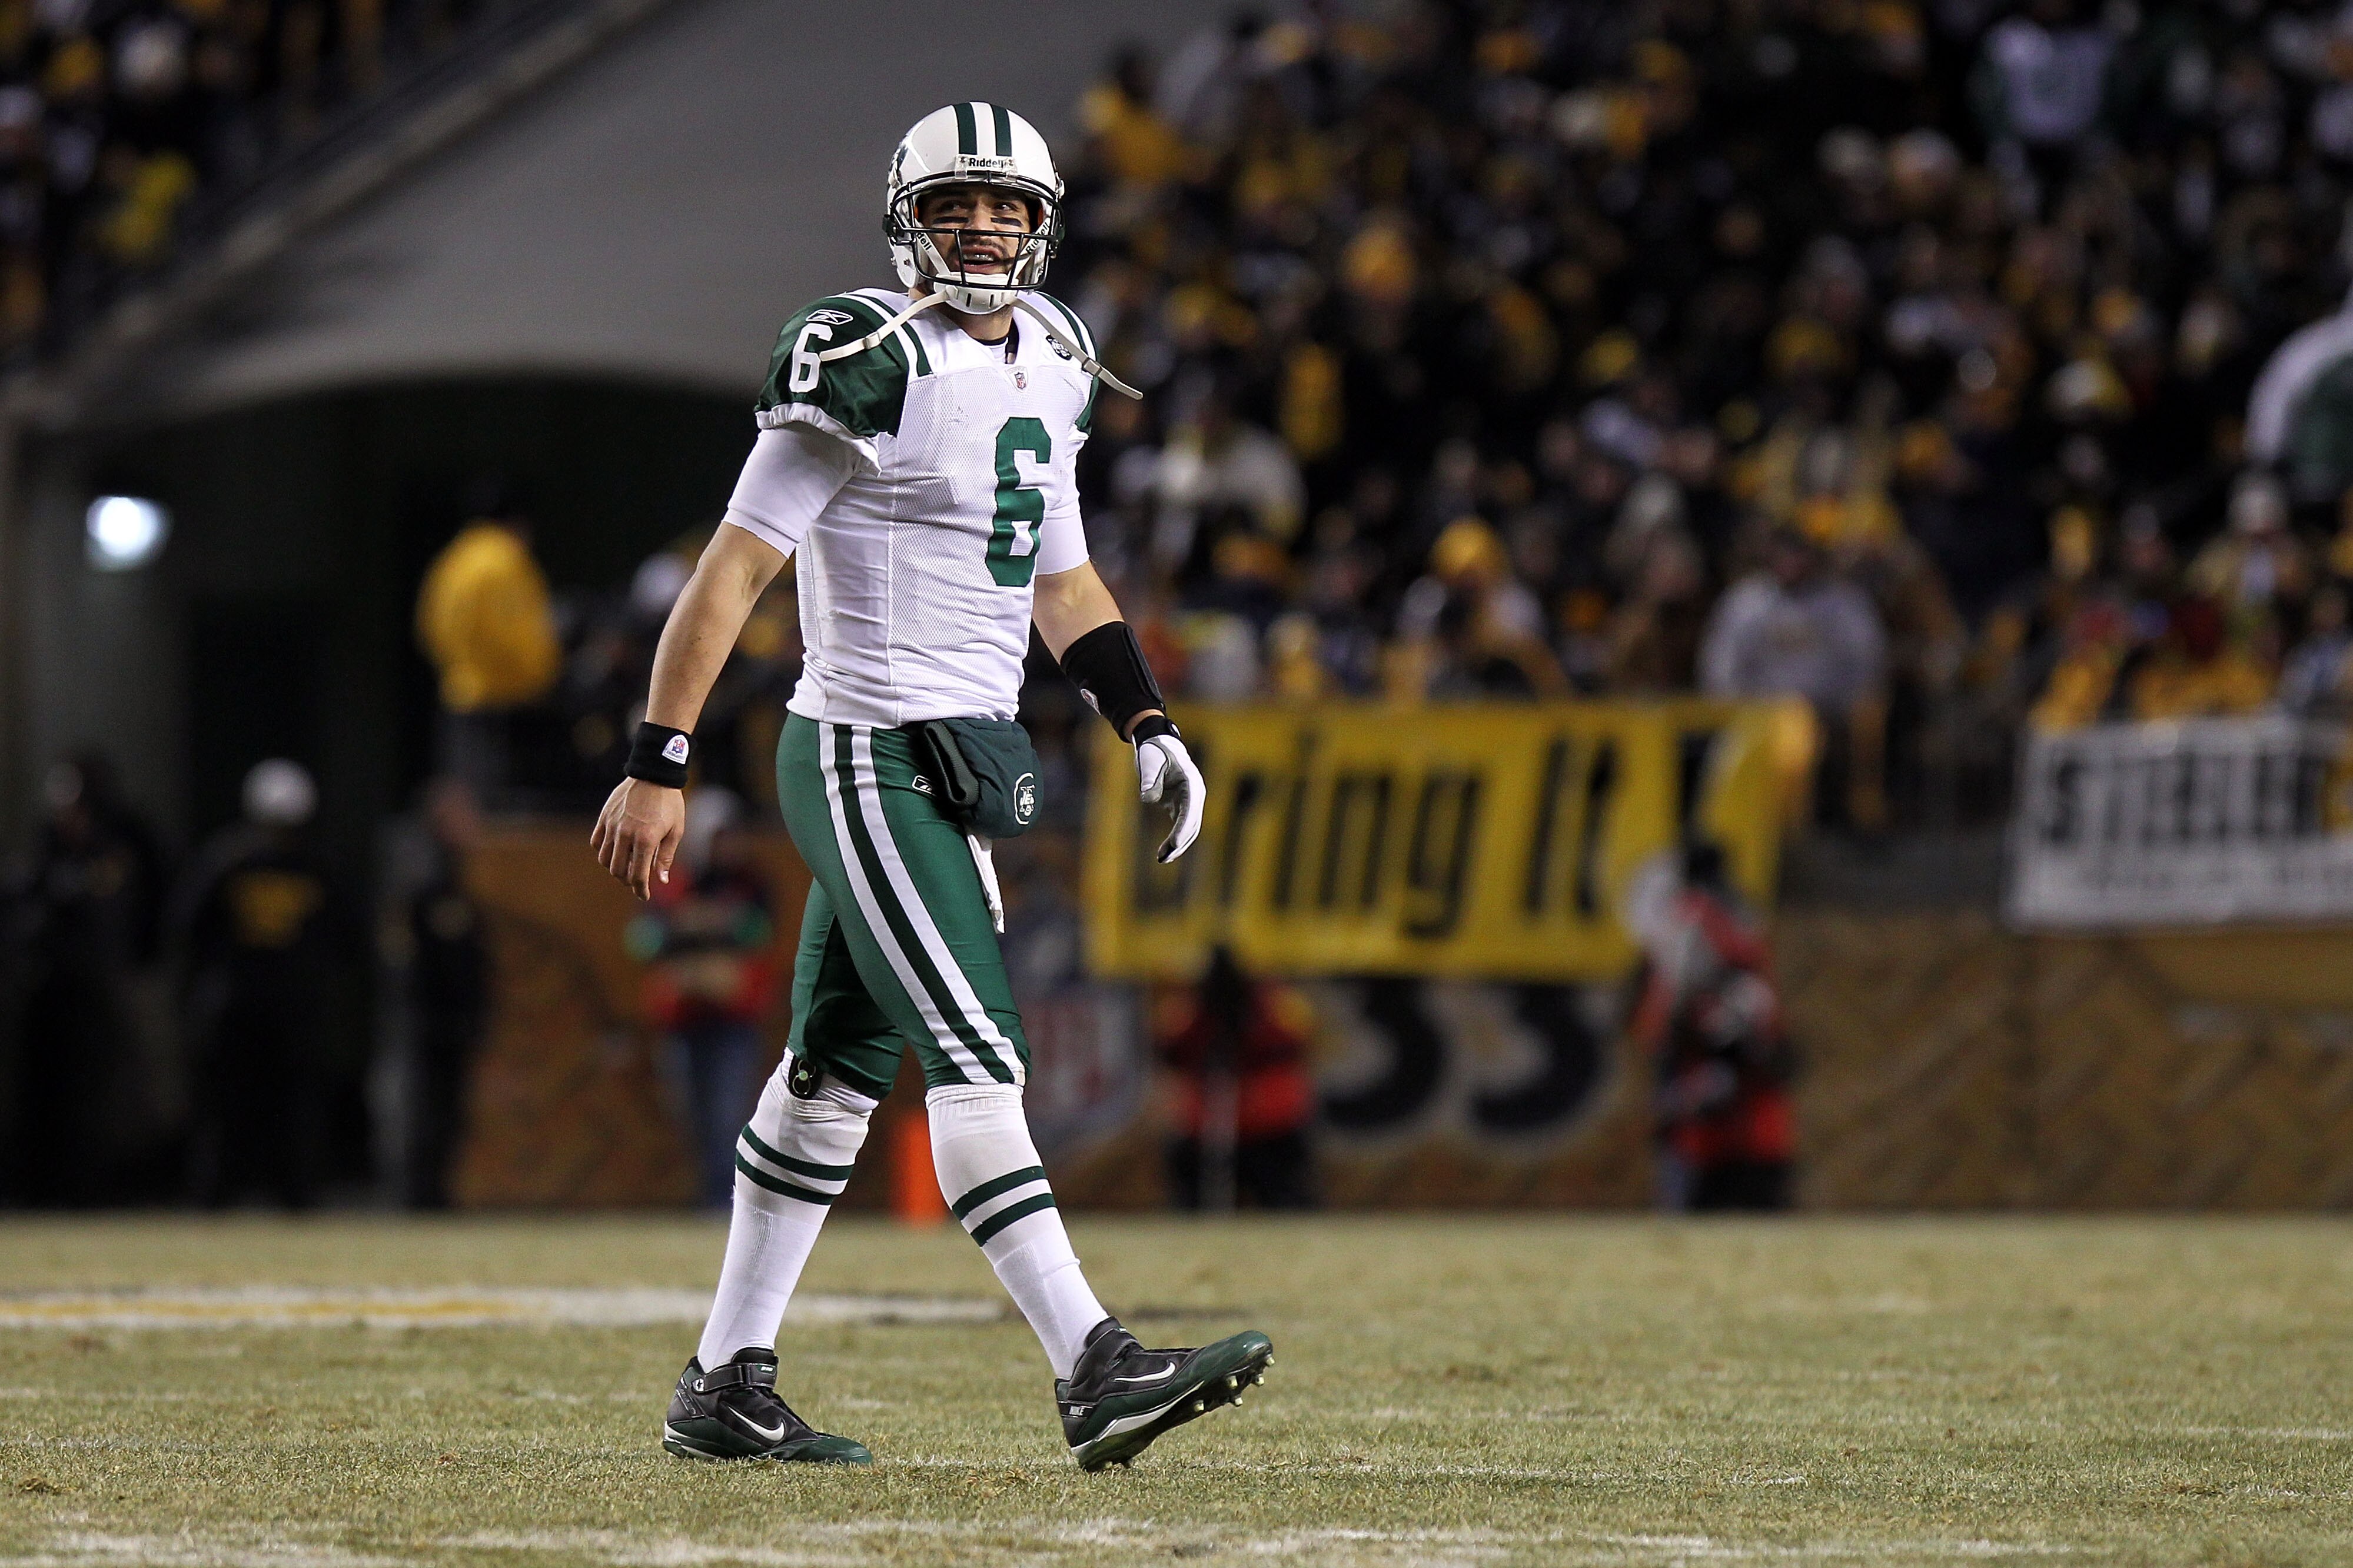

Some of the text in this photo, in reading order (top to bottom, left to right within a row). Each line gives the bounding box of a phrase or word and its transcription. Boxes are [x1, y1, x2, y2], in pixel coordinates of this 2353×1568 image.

[969, 158, 1004, 168] Riddell
[789, 322, 833, 394] 6
[985, 417, 1052, 588] 6
